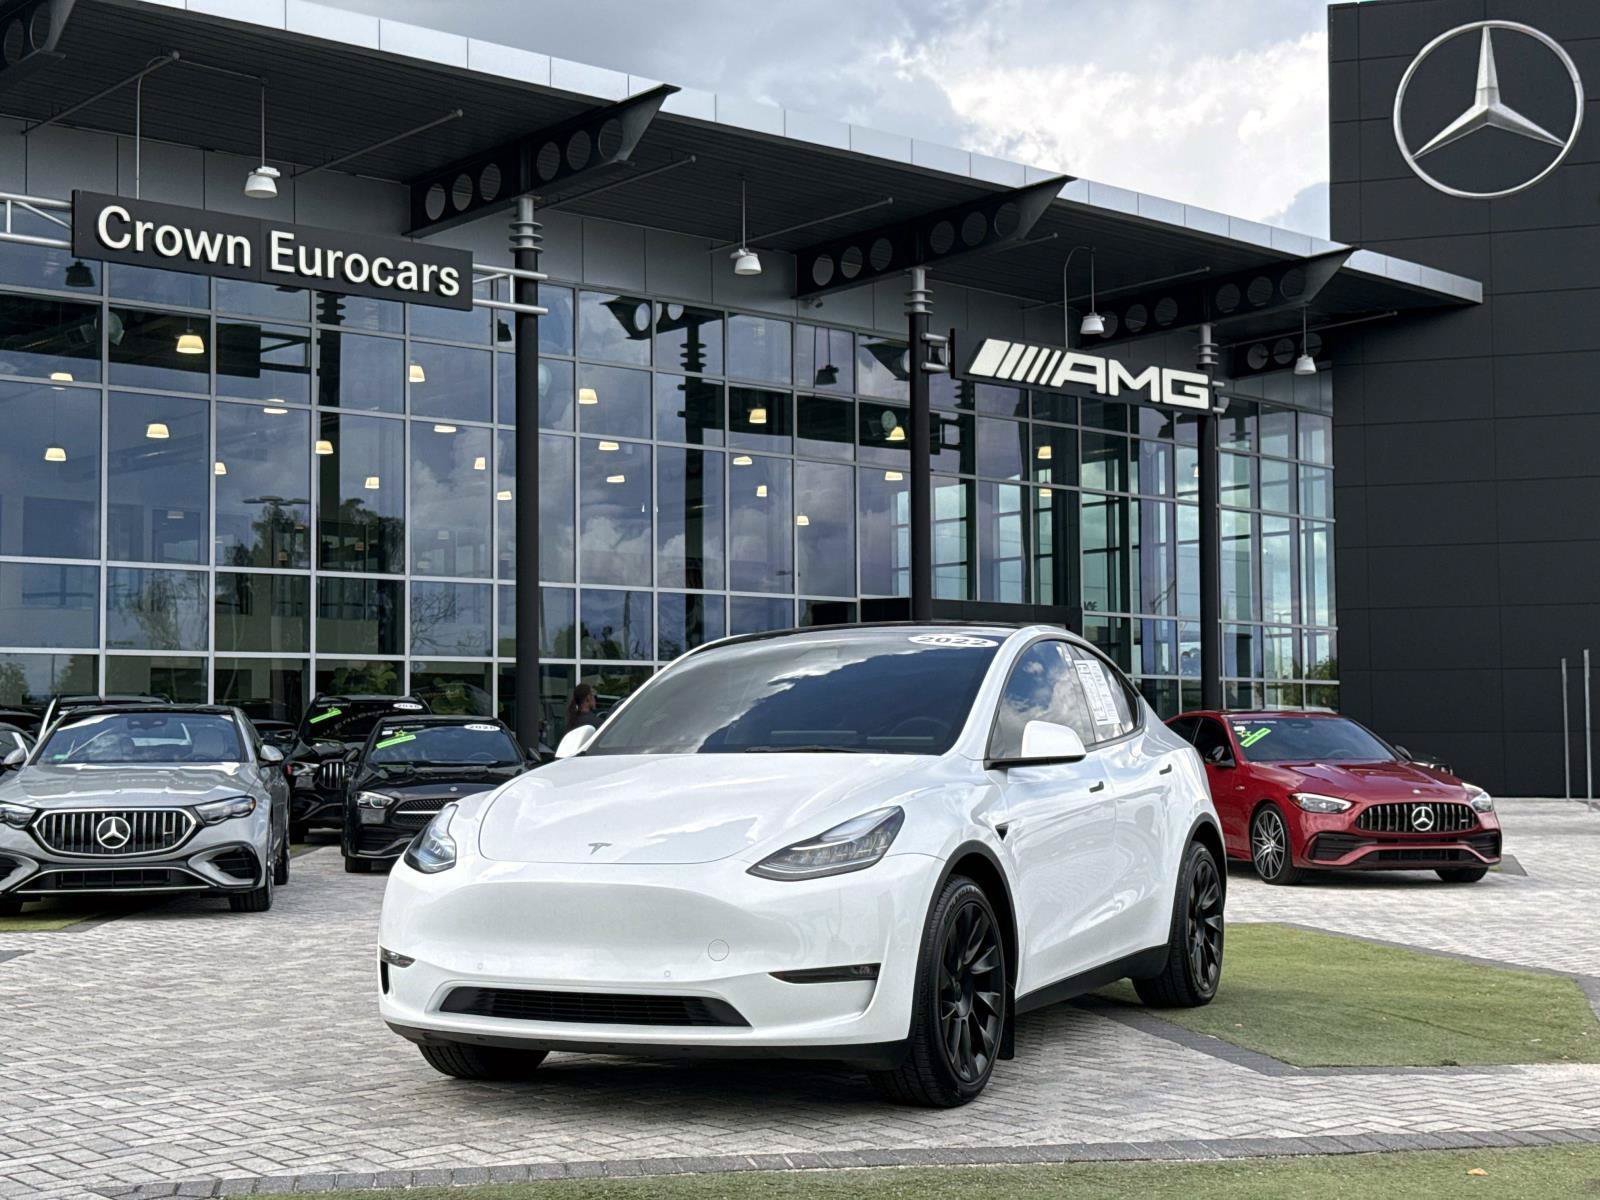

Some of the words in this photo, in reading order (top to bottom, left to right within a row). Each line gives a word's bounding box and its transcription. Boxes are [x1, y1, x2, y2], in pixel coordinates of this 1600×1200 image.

[97, 205, 252, 268] Crown
[270, 229, 461, 298] Eurocars
[1049, 351, 1210, 410] AMG
